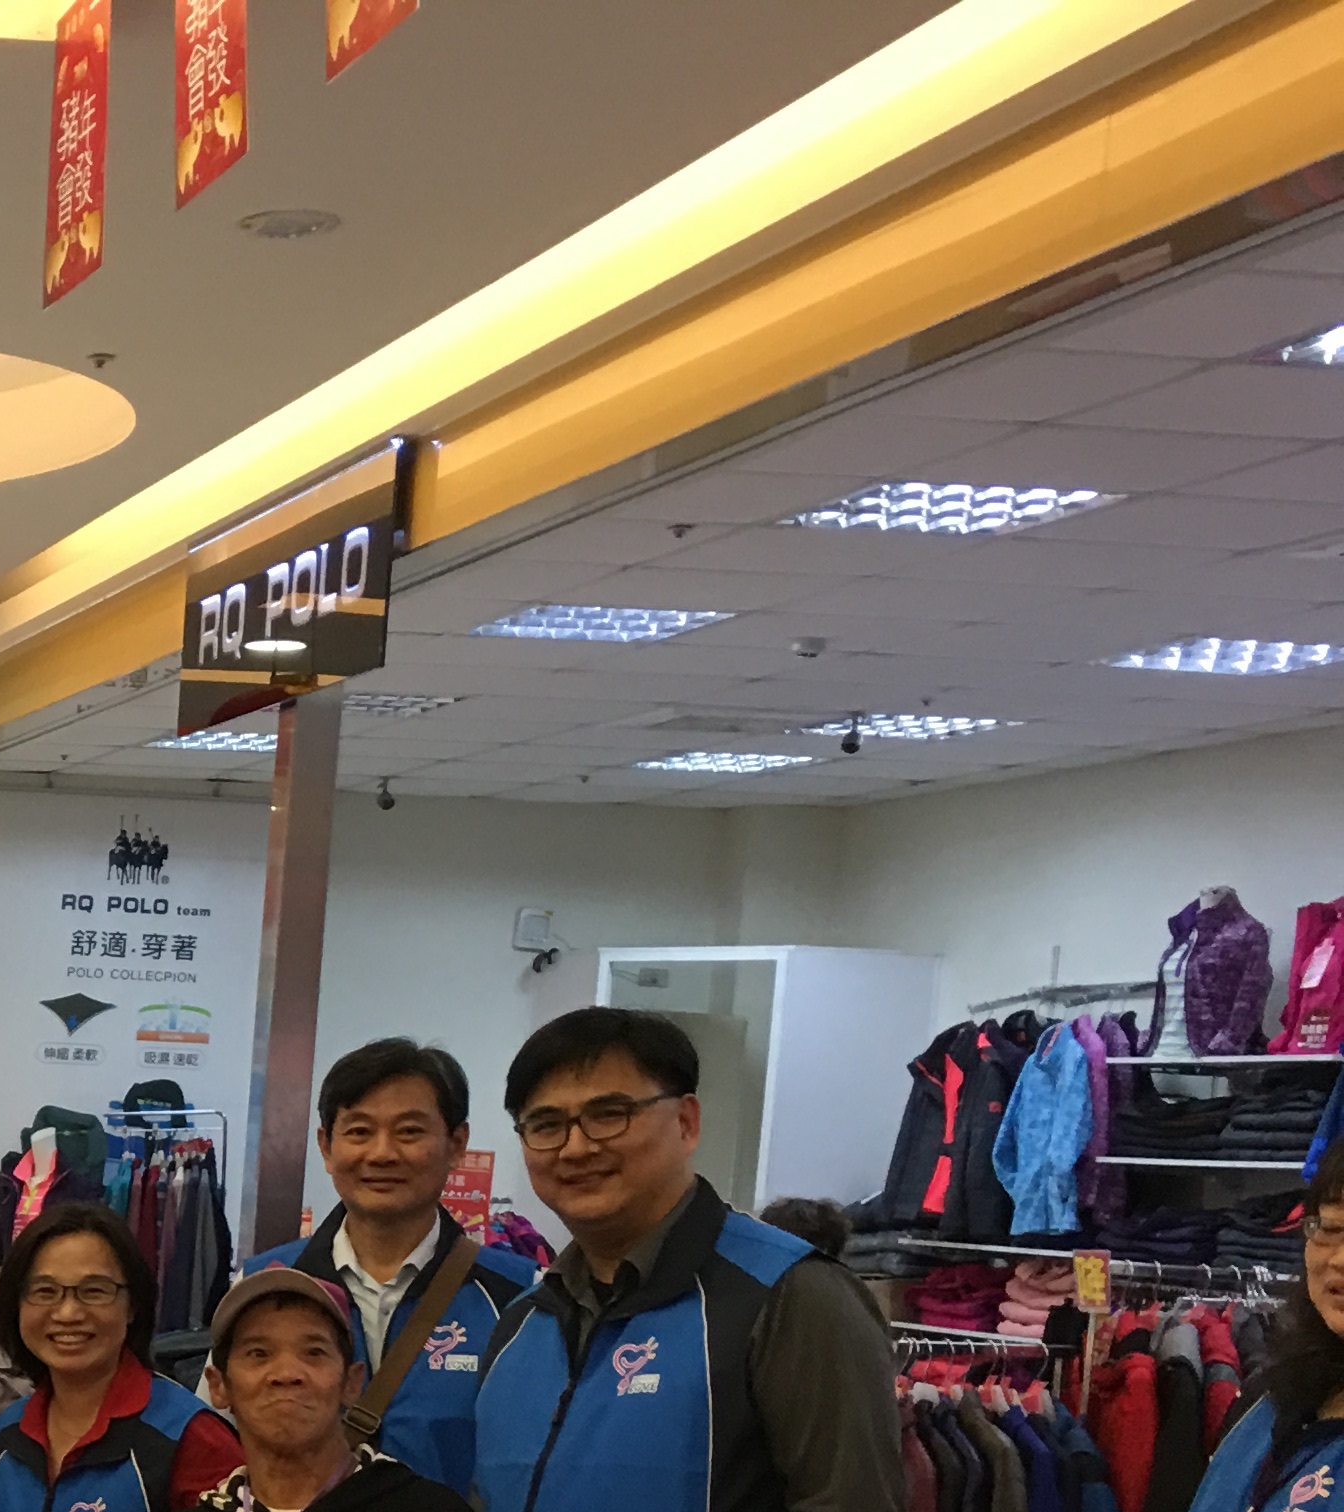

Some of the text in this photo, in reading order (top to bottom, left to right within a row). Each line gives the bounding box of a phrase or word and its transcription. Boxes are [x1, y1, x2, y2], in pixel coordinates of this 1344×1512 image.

[198, 526, 370, 668] RQ POLO
[61, 893, 212, 917] RQ POLO team
[67, 967, 104, 980] POLO
